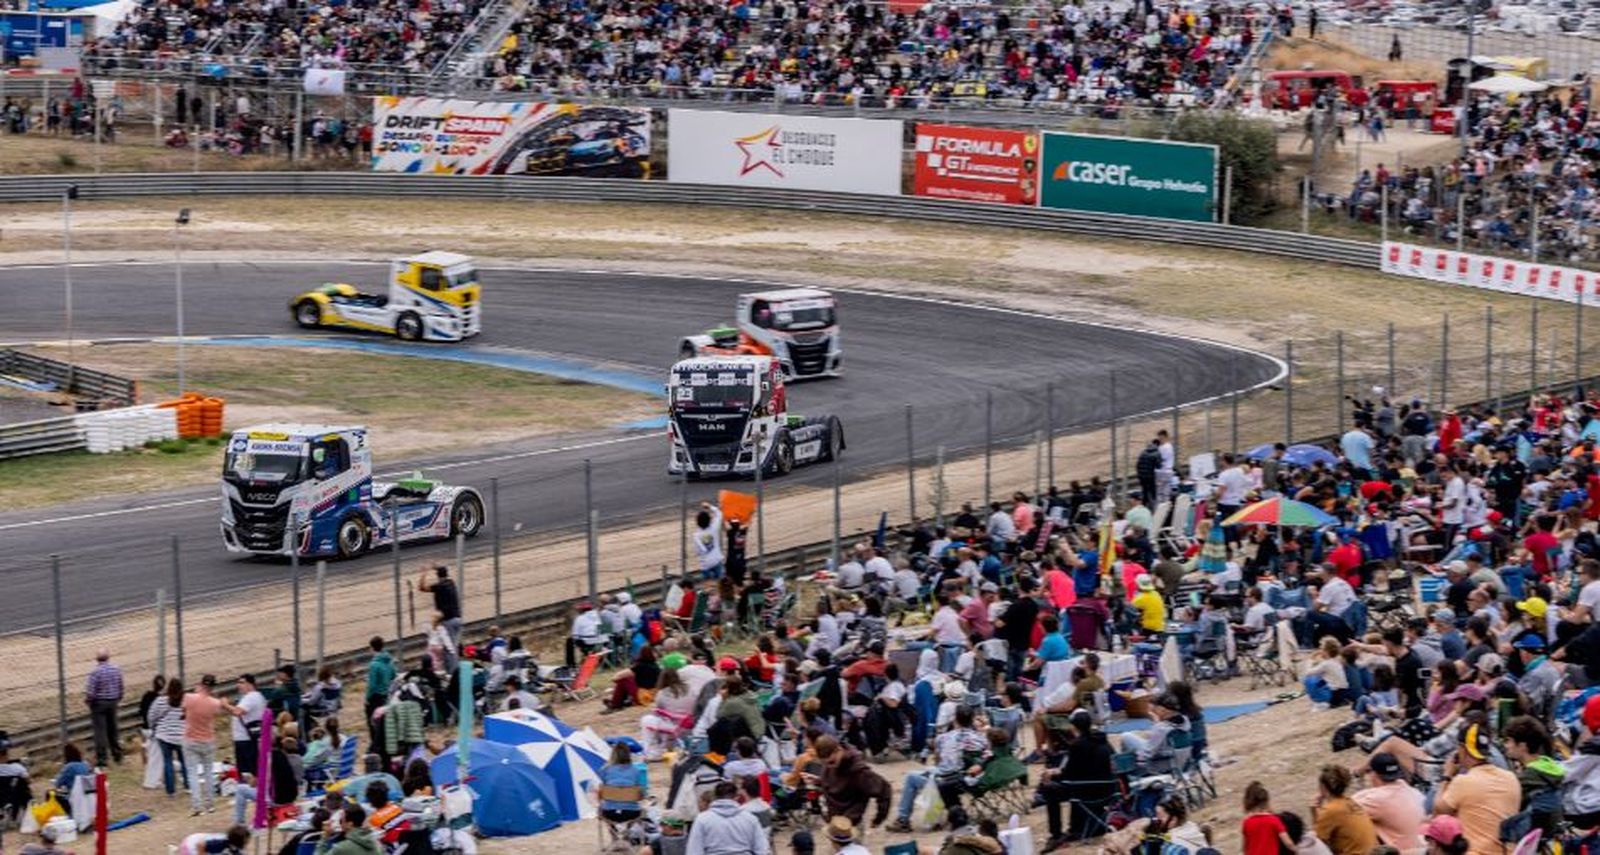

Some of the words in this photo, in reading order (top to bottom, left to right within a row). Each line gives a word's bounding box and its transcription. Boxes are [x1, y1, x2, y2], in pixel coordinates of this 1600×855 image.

[386, 115, 445, 130] DRIFT
[935, 137, 1021, 157] FORMULA
[788, 149, 835, 166] CHOQUE
[1067, 161, 1132, 186] caser
[698, 423, 727, 431] MAN
[246, 492, 277, 501] IVECO
